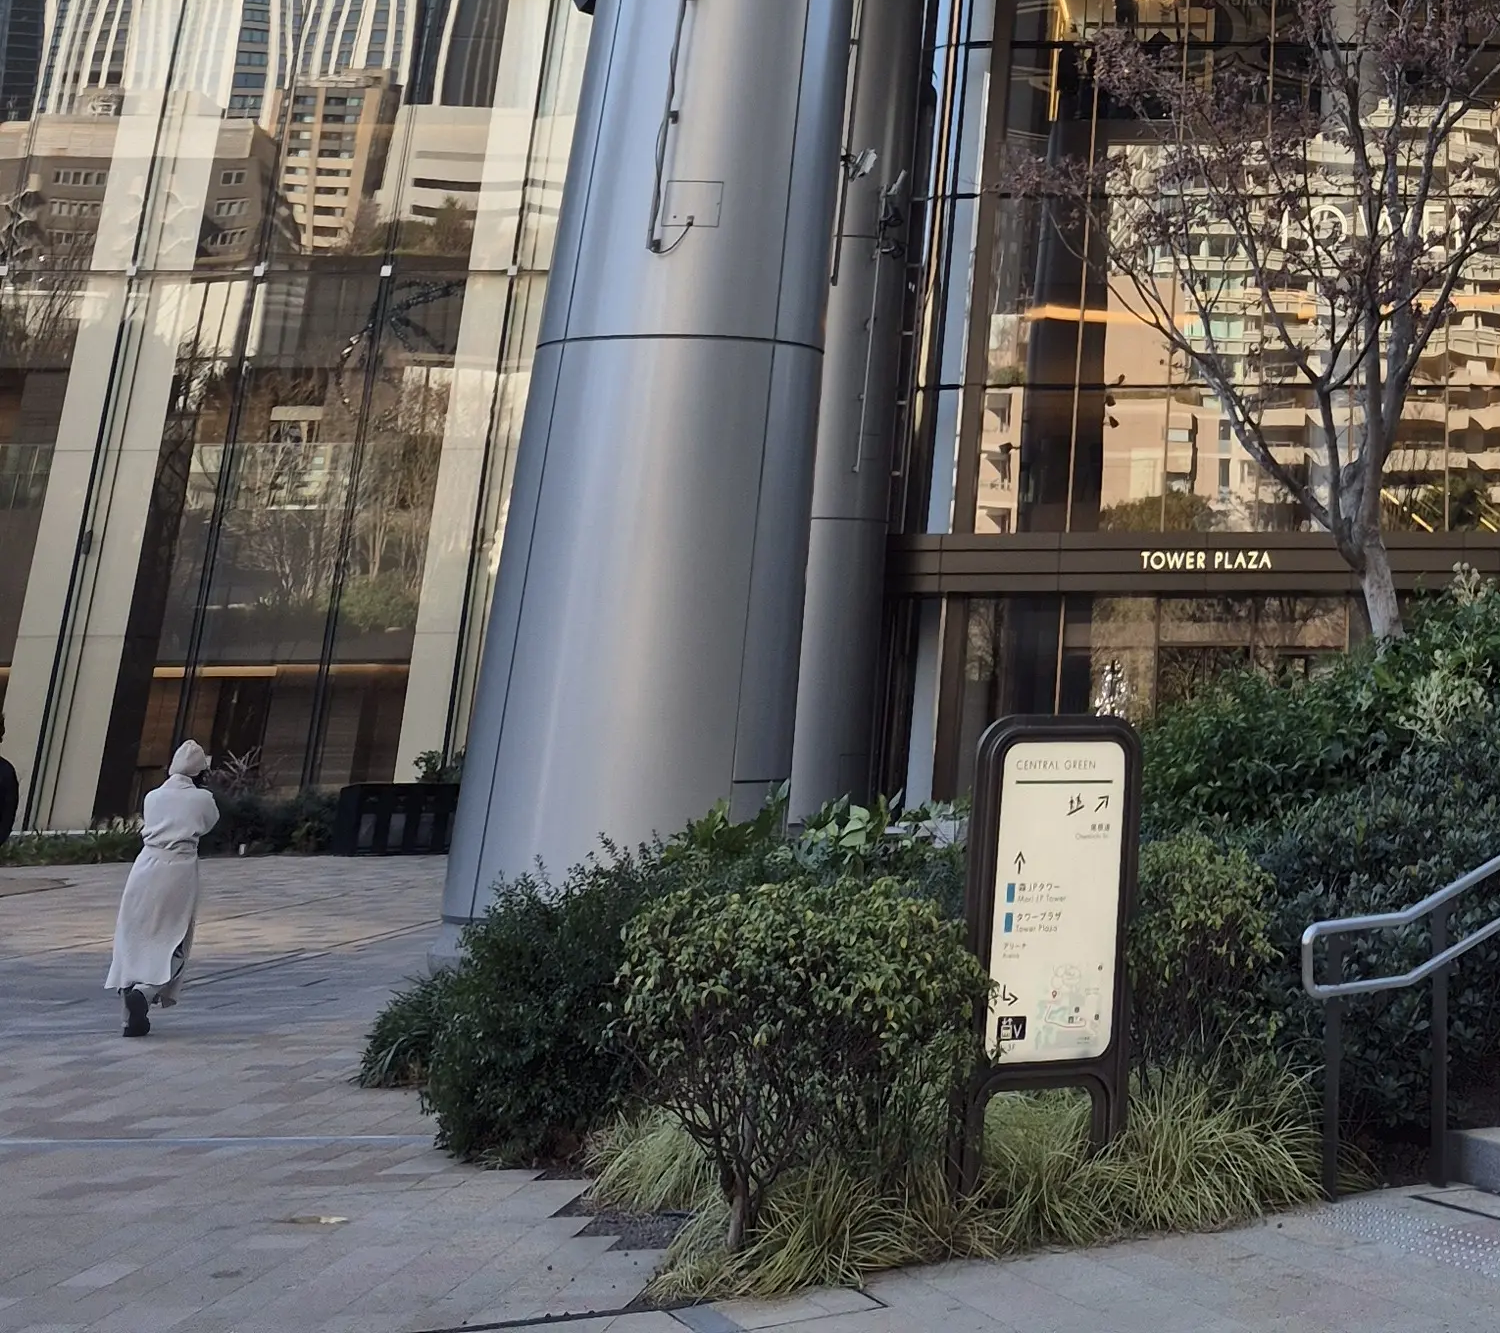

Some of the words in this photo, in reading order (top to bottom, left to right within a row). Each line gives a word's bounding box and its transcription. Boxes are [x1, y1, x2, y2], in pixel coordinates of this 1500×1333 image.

[1140, 550, 1206, 570] TOWER
[1214, 550, 1273, 570] PLAZA
[1016, 759, 1059, 771] CENTRAL
[1064, 759, 1096, 770] GREEN
[1013, 1024, 1022, 1039] V
